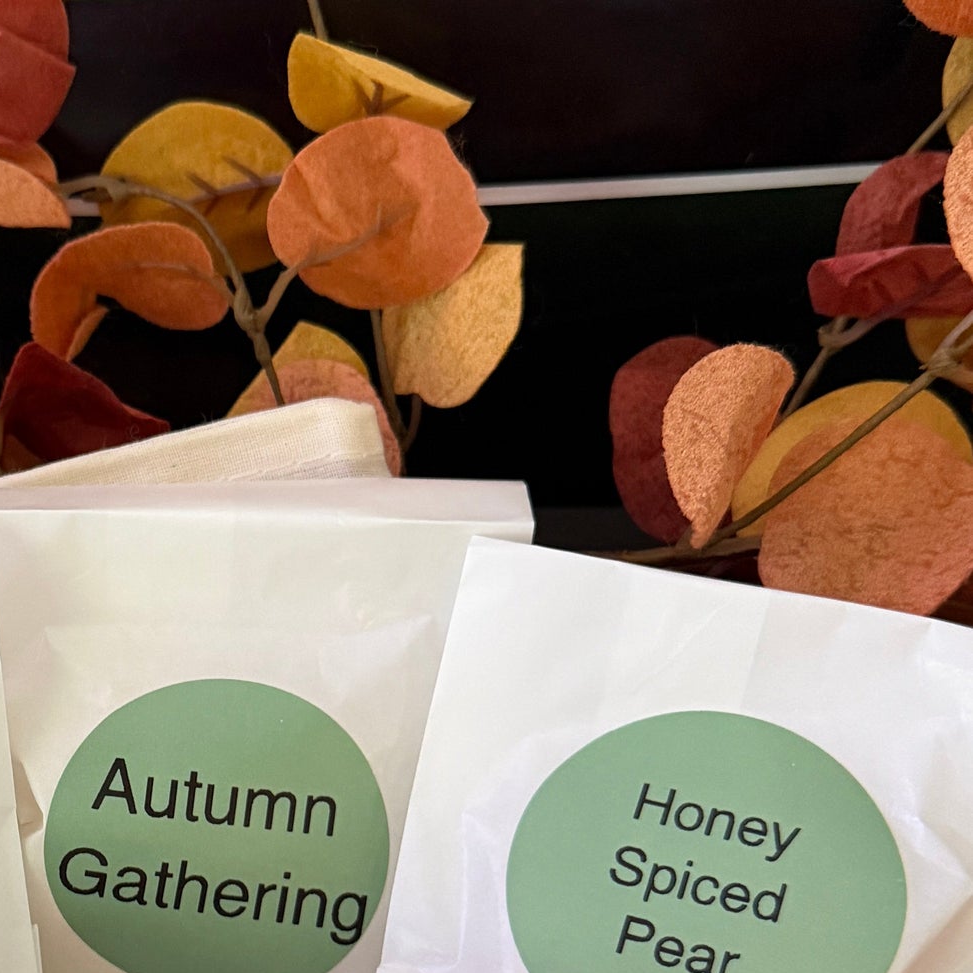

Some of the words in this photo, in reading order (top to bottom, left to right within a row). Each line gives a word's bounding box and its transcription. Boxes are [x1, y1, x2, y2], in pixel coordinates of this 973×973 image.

[90, 756, 338, 838] Autumn
[632, 782, 803, 863] Honey
[57, 846, 369, 948] Gathering
[608, 845, 789, 924] Spiced
